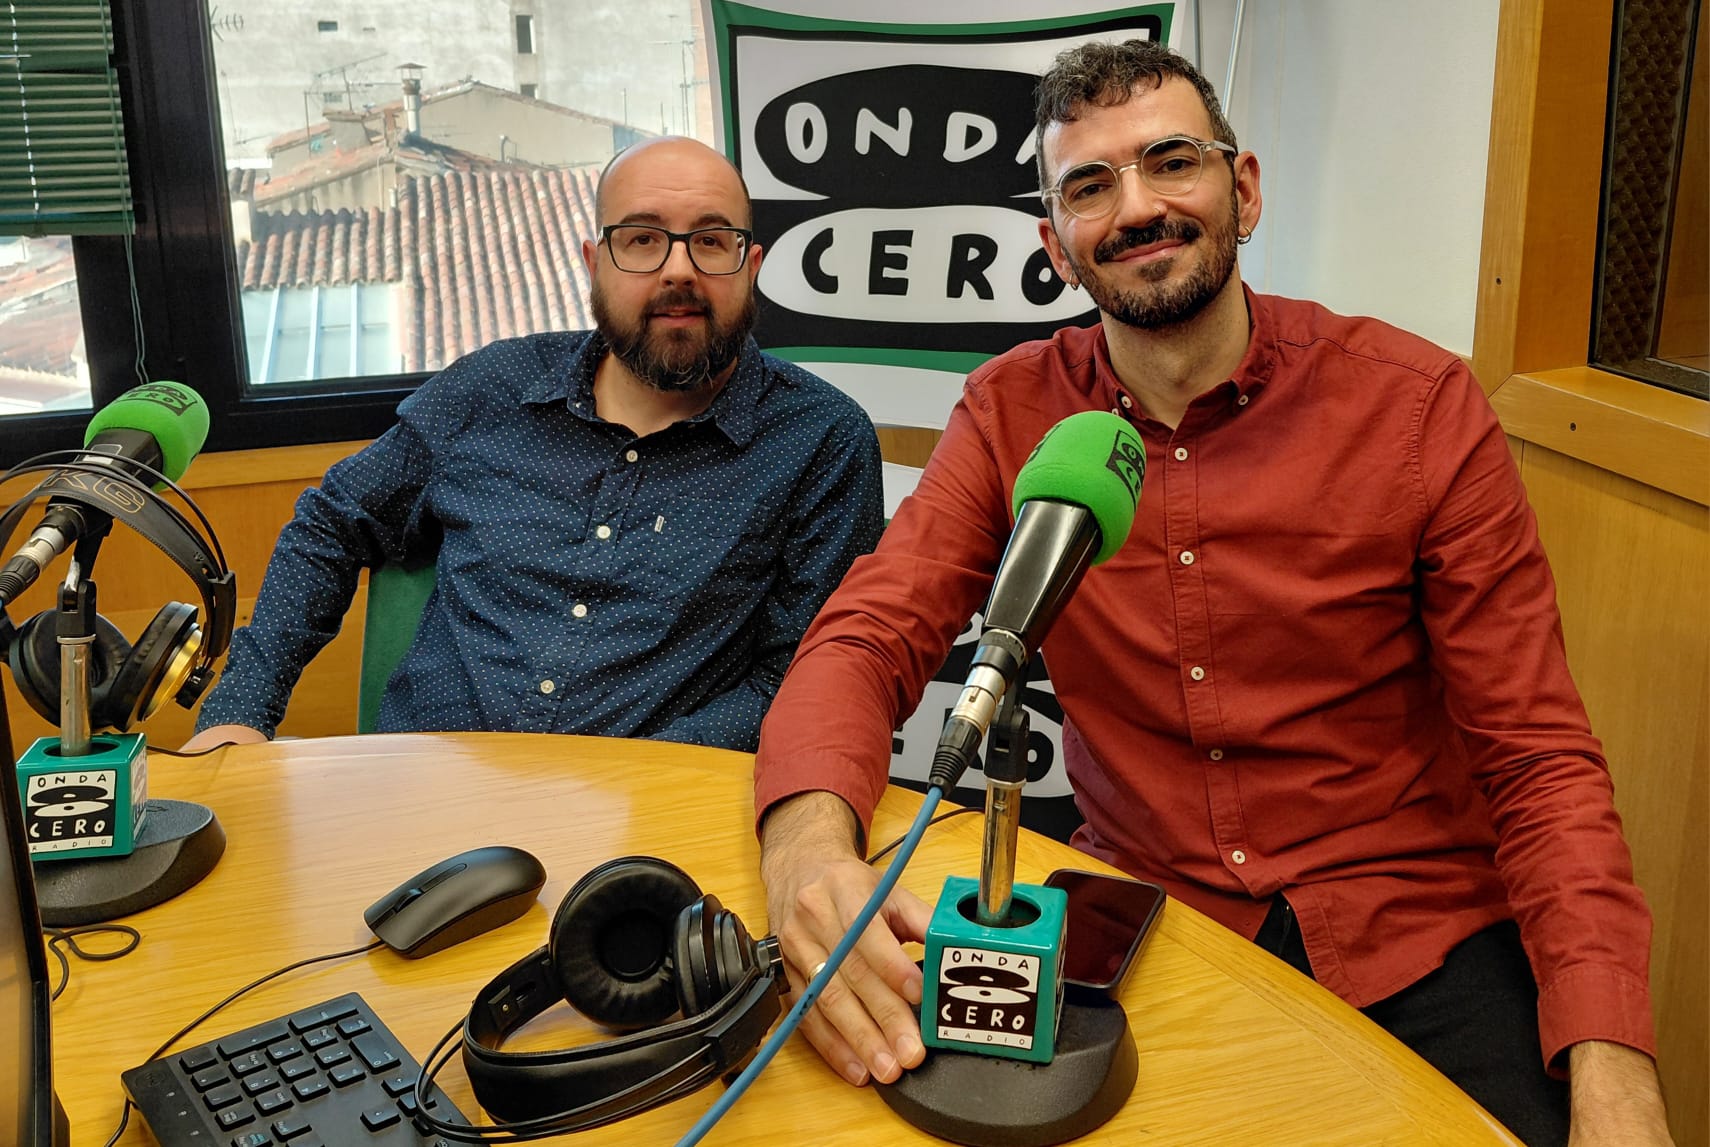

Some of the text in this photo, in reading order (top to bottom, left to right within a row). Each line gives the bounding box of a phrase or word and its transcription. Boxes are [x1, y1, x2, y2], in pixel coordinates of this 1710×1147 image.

[802, 227, 1067, 306] CERO
[47, 469, 145, 514] KG
[37, 773, 107, 788] ONDA
[30, 819, 106, 838] CERO
[32, 839, 107, 852] RADIO
[952, 950, 1029, 970] ONDA
[941, 1003, 1026, 1030] CERO
[943, 1029, 1026, 1046] RADIO
